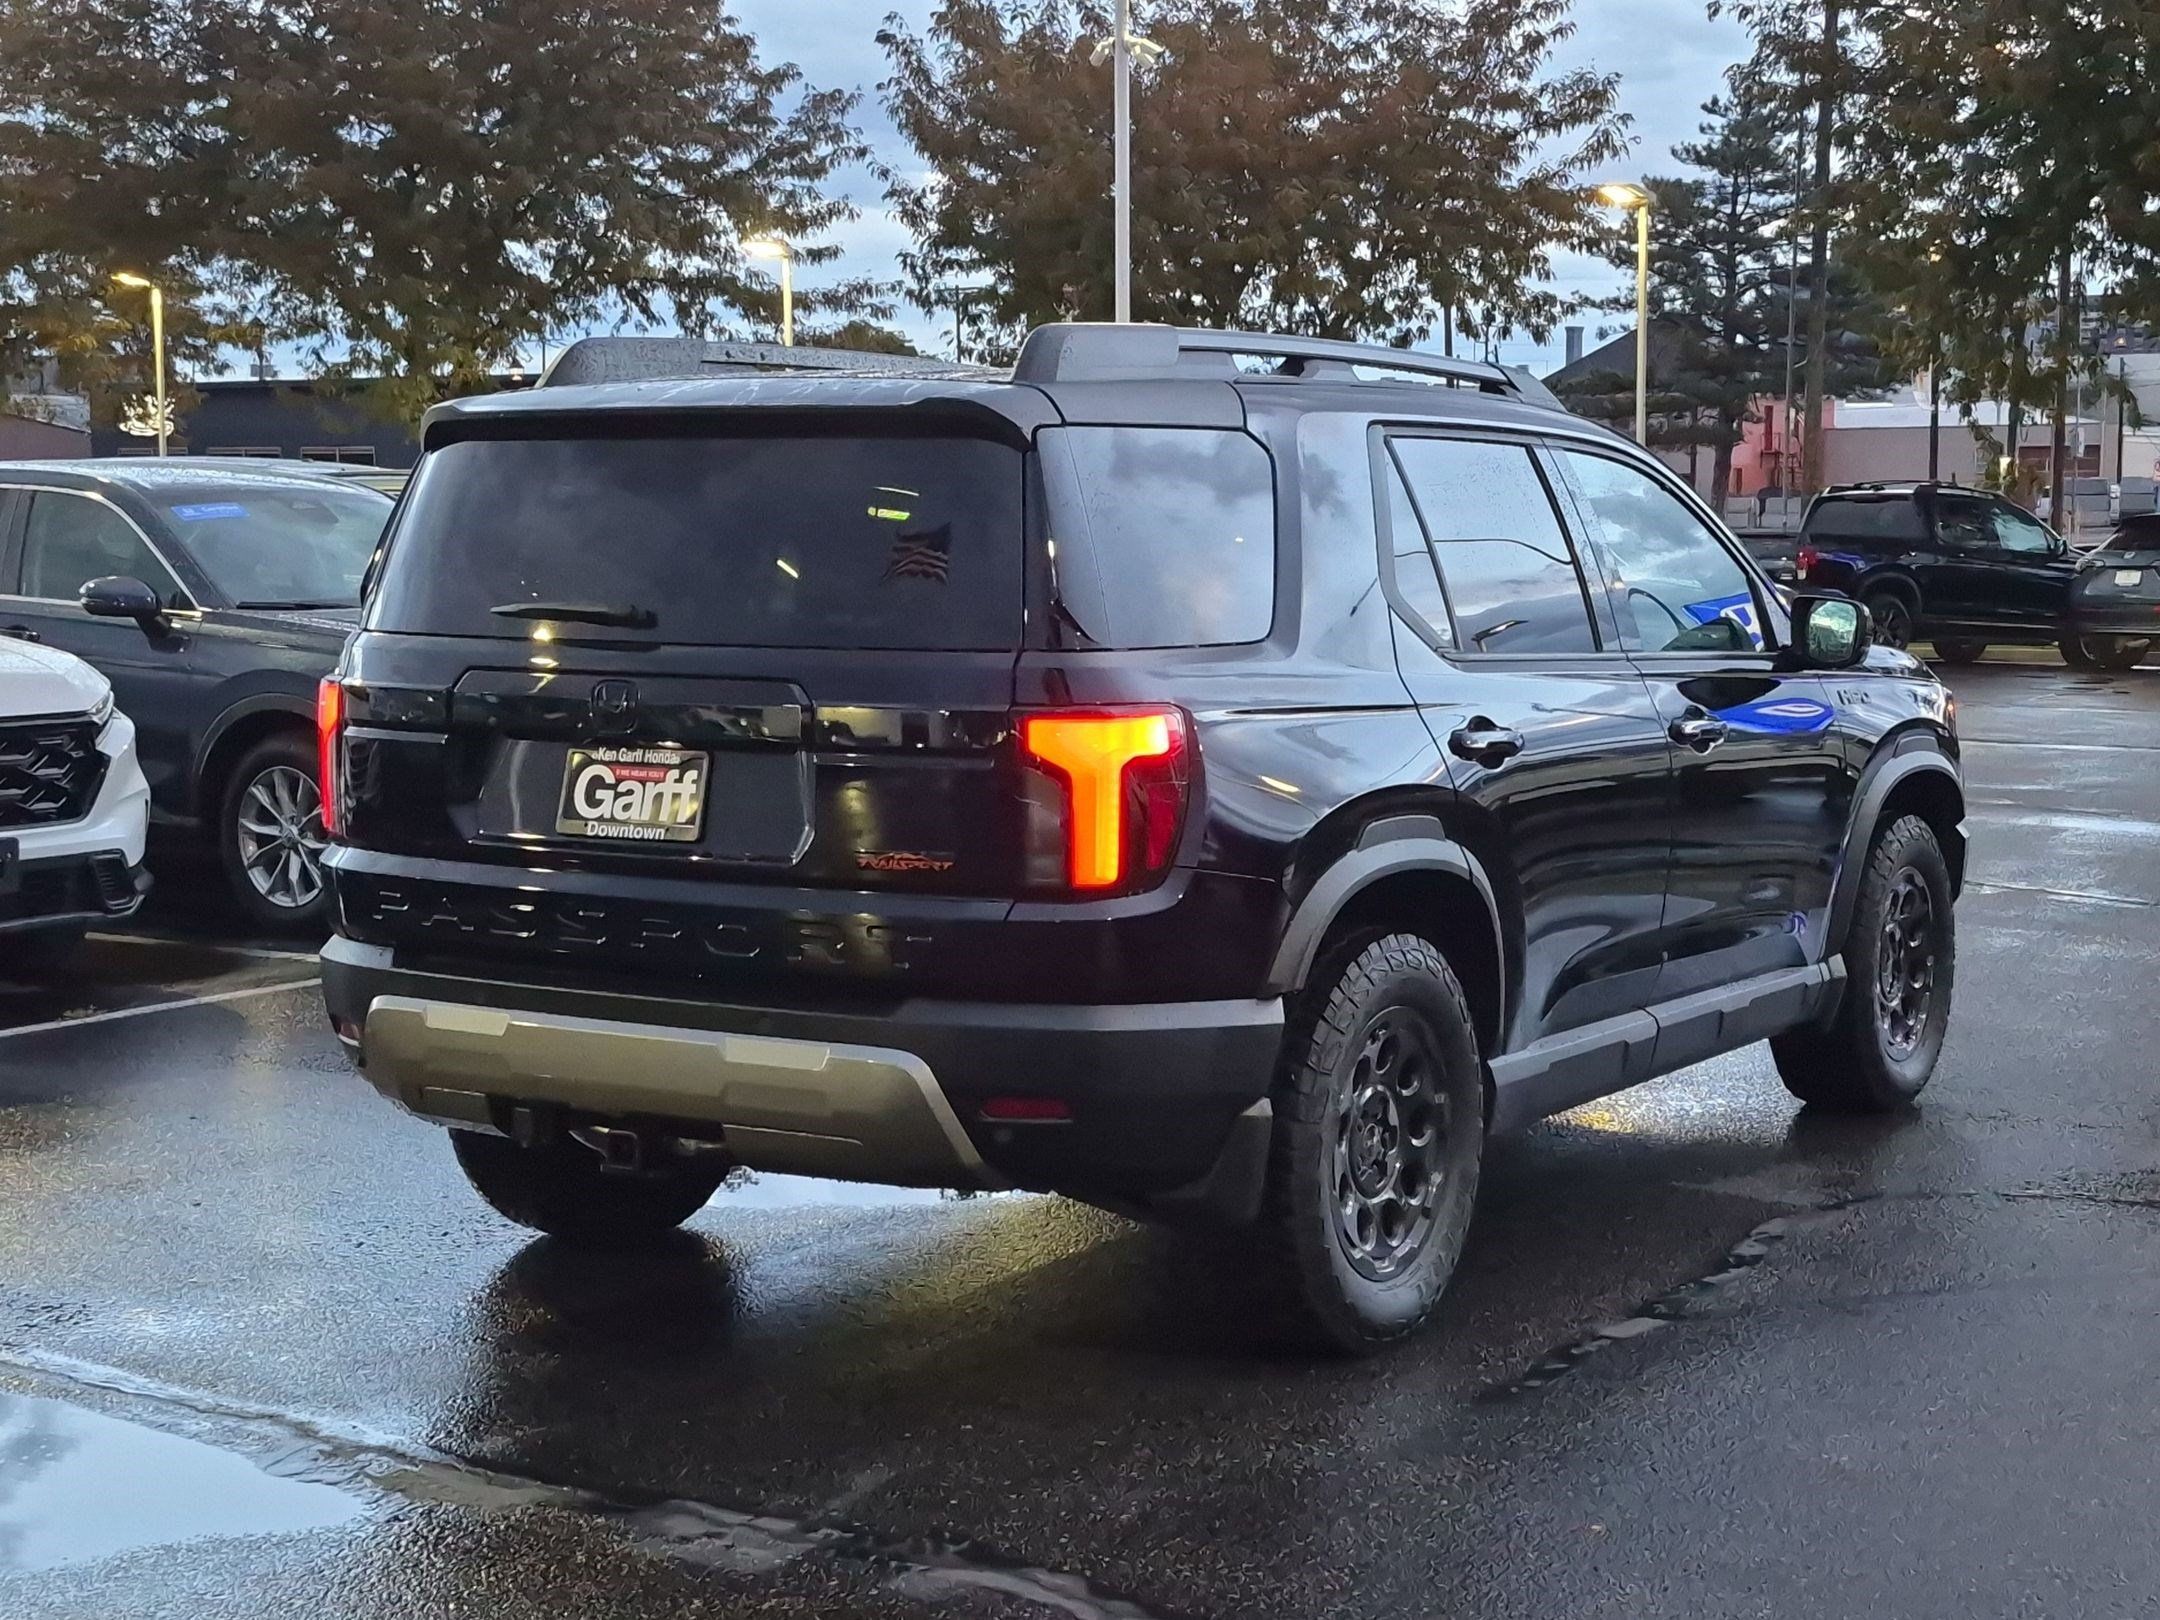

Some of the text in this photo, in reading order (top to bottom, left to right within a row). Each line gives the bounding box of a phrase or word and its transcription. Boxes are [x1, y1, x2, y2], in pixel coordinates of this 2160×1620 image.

[598, 747, 616, 761] Ken
[644, 749, 679, 764] Honda
[574, 764, 698, 823] Garff
[587, 821, 666, 840] Downtown
